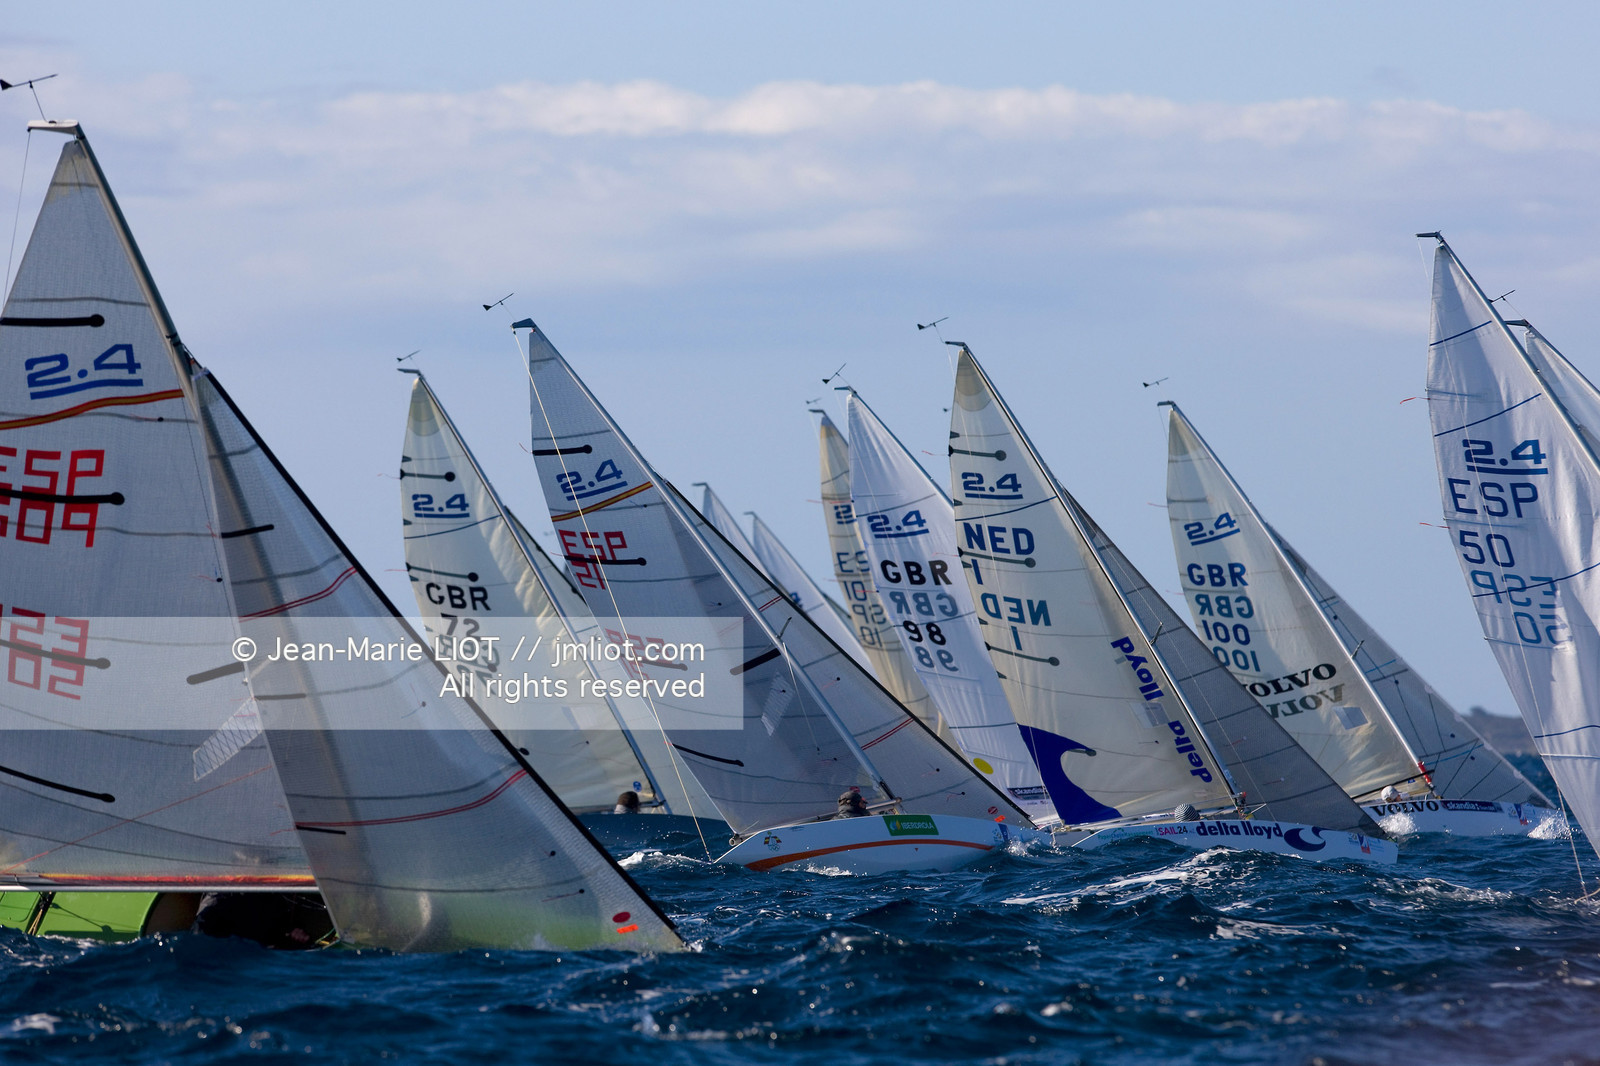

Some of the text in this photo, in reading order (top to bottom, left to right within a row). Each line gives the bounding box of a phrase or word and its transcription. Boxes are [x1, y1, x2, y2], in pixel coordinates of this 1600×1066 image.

[25, 344, 142, 388] 2.4
[1462, 439, 1547, 467] 2.4
[556, 459, 624, 494] 2.4
[961, 472, 1022, 493] 2.4
[411, 493, 470, 512] 2.4
[1447, 478, 1539, 518] ESP
[0, 494, 99, 548] 09
[867, 510, 927, 532] 2.4
[1184, 512, 1237, 541] 2.4
[559, 529, 628, 562] ESP
[963, 522, 1036, 555] NED
[1459, 529, 1515, 568] 50
[837, 551, 871, 573] ES
[880, 559, 953, 586] GBR
[1187, 563, 1249, 587] GBR
[426, 582, 492, 611] GBR
[441, 613, 481, 641] 72
[902, 620, 947, 646] 98
[1201, 620, 1252, 646] 100
[1241, 663, 1337, 697] OLVO
[1110, 636, 1213, 783] delta lloyd
[1370, 800, 1440, 817] VOLVO
[1195, 821, 1241, 837] delta
[1241, 821, 1285, 840] lloyd
